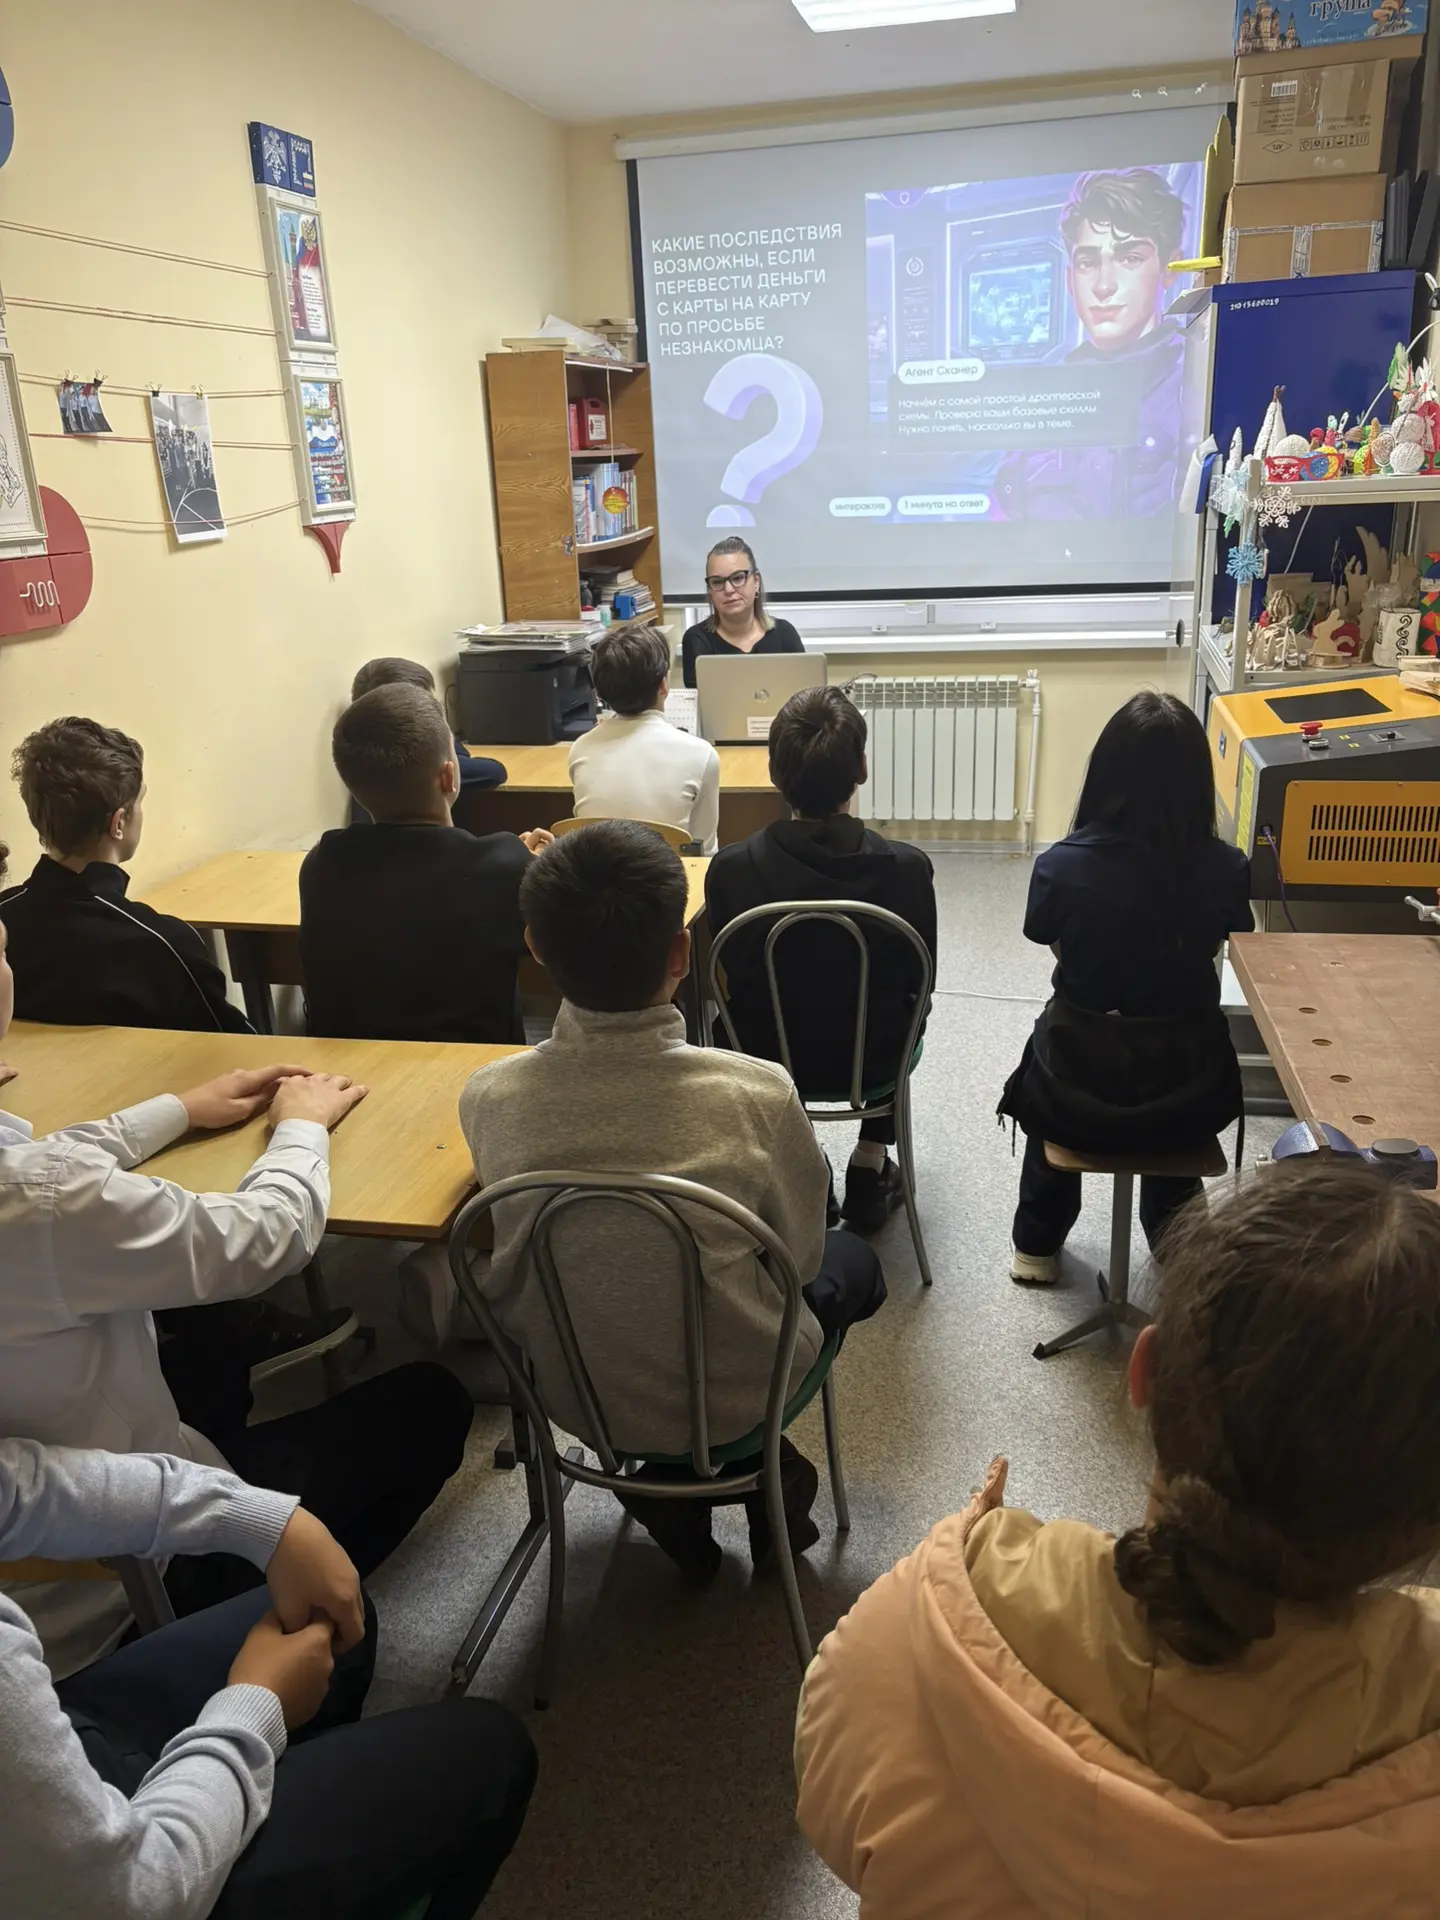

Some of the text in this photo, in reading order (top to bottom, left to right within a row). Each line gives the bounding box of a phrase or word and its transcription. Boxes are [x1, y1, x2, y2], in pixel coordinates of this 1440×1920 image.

[652, 224, 842, 253] КАКИЕ ПОСЛЕДСТВИЯ
[654, 248, 815, 275] ВОЗМОЖНЫ, ЕСЛИ
[656, 269, 826, 295] ПЕРЕВЕСТИ ДЕНЬГИ
[657, 292, 812, 316] С КАРТЫ НА КАРТУ
[659, 317, 765, 336] ПО ПРОСЬБЕ
[661, 336, 784, 356] НЕЗНАКОМЦА?
[905, 365, 978, 377] Агент Сканер
[938, 398, 945, 406] с
[947, 395, 981, 406] самой
[983, 391, 1025, 405] простой
[1012, 406, 1057, 417] базовые
[898, 425, 930, 436] Нужно
[968, 421, 1021, 432] насколько
[1023, 421, 1036, 430] вы
[1038, 420, 1044, 429] в
[904, 499, 984, 510] 1 минута на ответ
